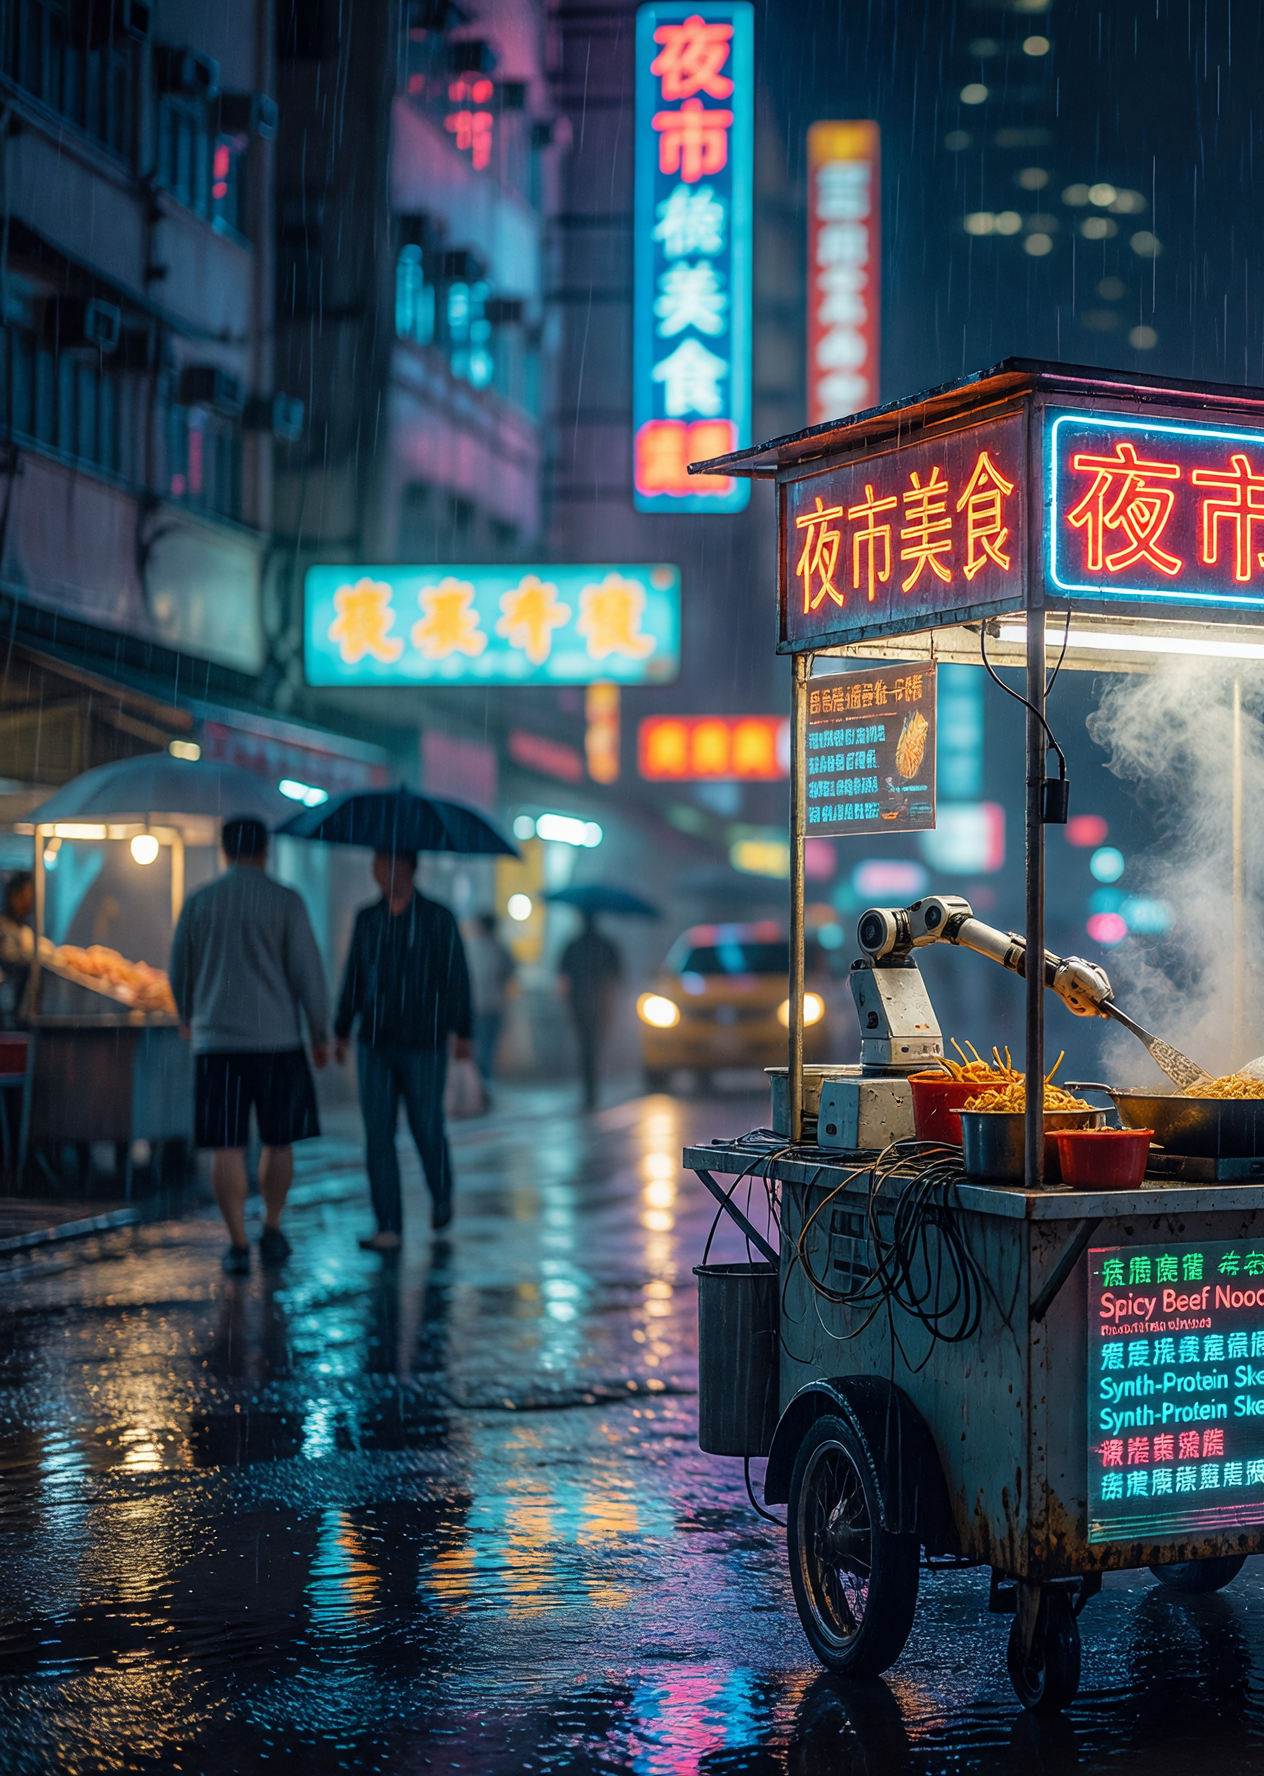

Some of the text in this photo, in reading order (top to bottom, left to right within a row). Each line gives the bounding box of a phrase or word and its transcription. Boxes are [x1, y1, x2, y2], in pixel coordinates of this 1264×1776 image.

[795, 450, 1015, 614] 夜市美食
[1099, 1292, 1157, 1323] Spicy
[1163, 1286, 1210, 1314] Beef
[1099, 1368, 1229, 1404] Synth-Protein
[1099, 1398, 1228, 1436] Synth-Protein
